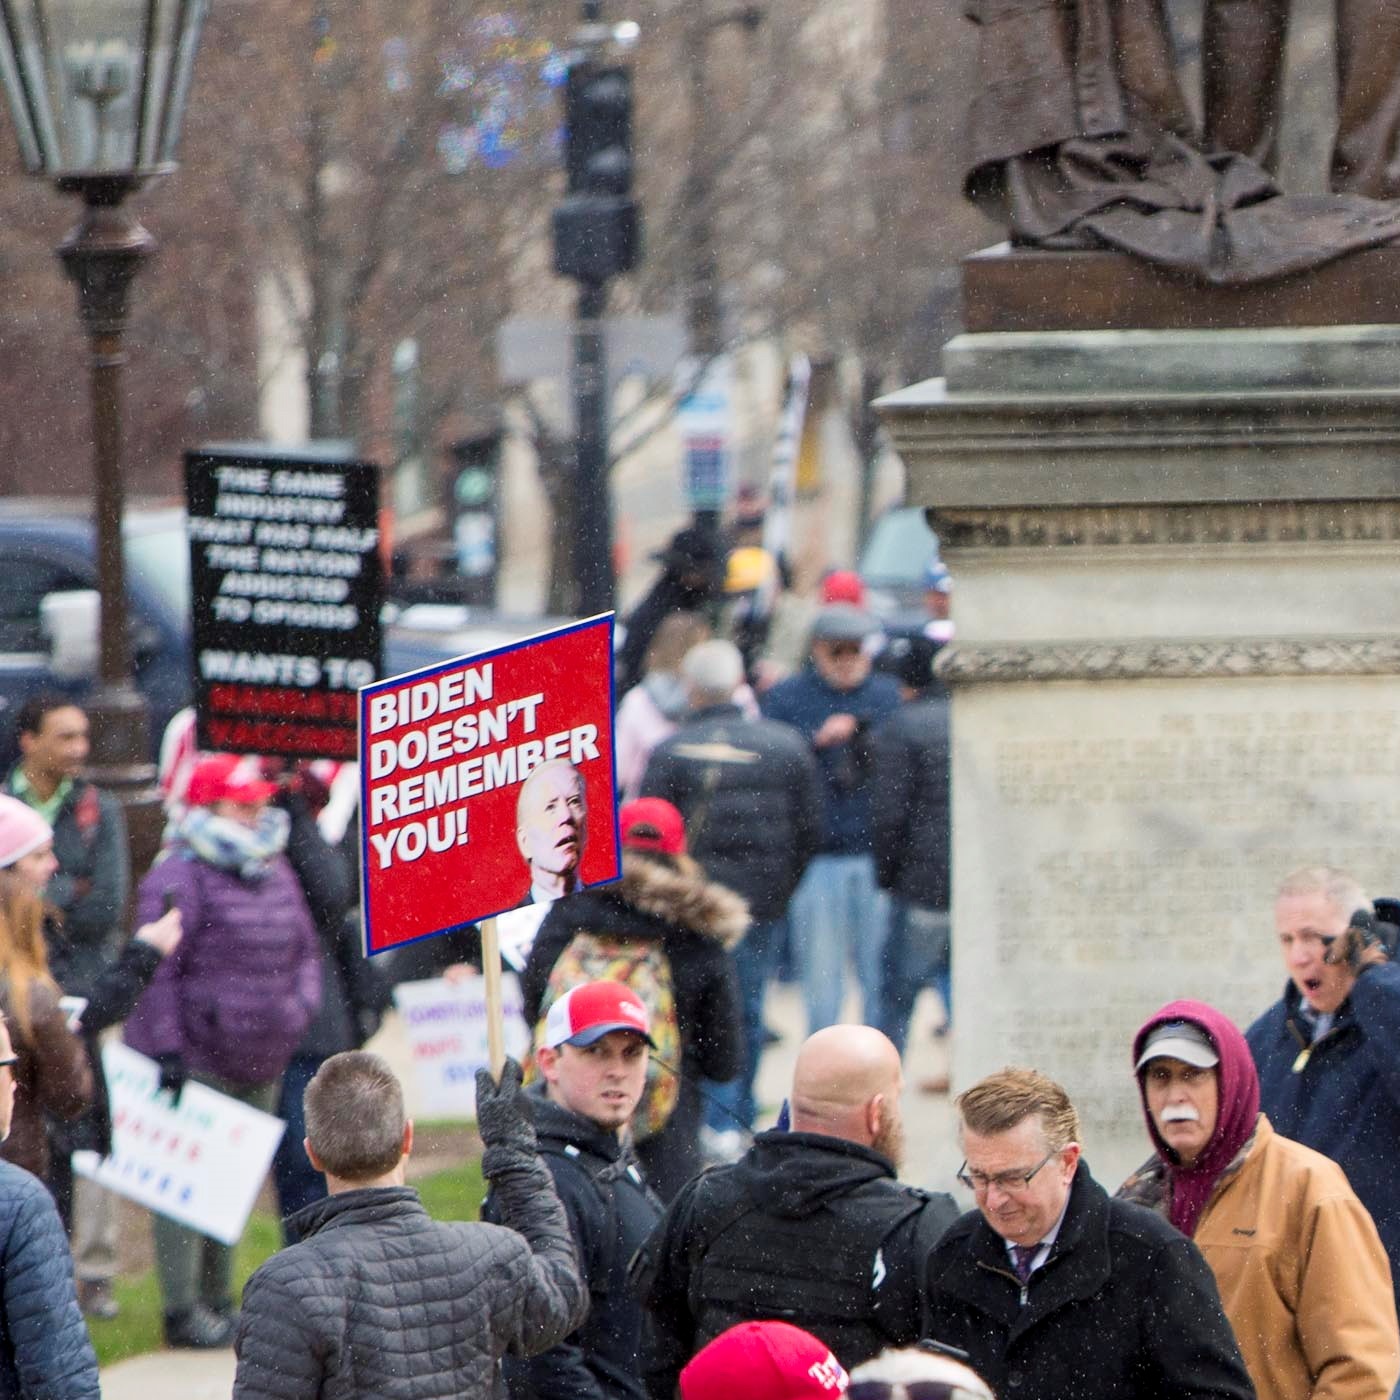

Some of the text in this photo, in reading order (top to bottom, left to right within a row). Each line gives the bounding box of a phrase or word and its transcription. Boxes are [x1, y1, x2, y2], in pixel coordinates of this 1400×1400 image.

[214, 466, 271, 493] THE
[214, 492, 347, 524] INDUSTRY
[188, 516, 253, 543] THAT
[204, 544, 362, 579] THE NATION
[219, 571, 350, 602] ADDICTED
[212, 596, 360, 631] TO OPIOIDS
[199, 648, 376, 690] WANTS TO
[370, 663, 494, 736] BIDEN
[370, 693, 544, 781] DOESN'T
[370, 724, 601, 827] REMEMBER
[369, 808, 470, 871] YOU!
